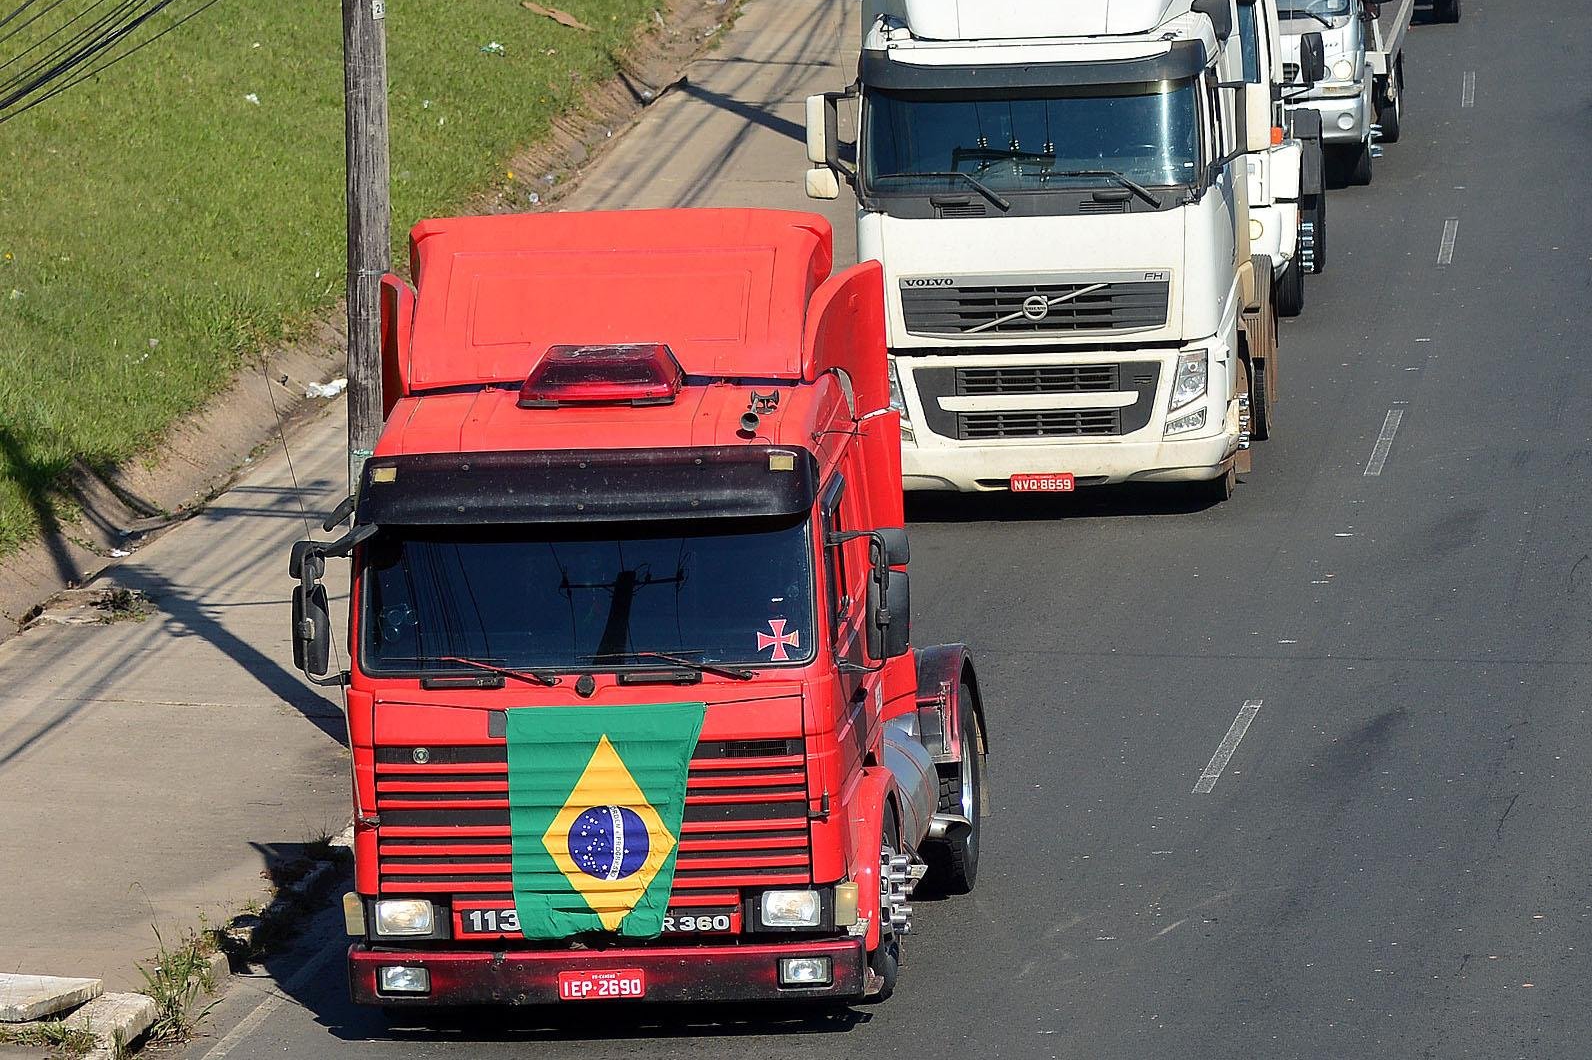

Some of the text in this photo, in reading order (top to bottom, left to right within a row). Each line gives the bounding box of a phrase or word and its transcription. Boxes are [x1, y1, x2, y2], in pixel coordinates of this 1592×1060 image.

[904, 272, 1163, 287] VOLVO FH
[469, 909, 521, 930] 113
[679, 916, 729, 931] 360
